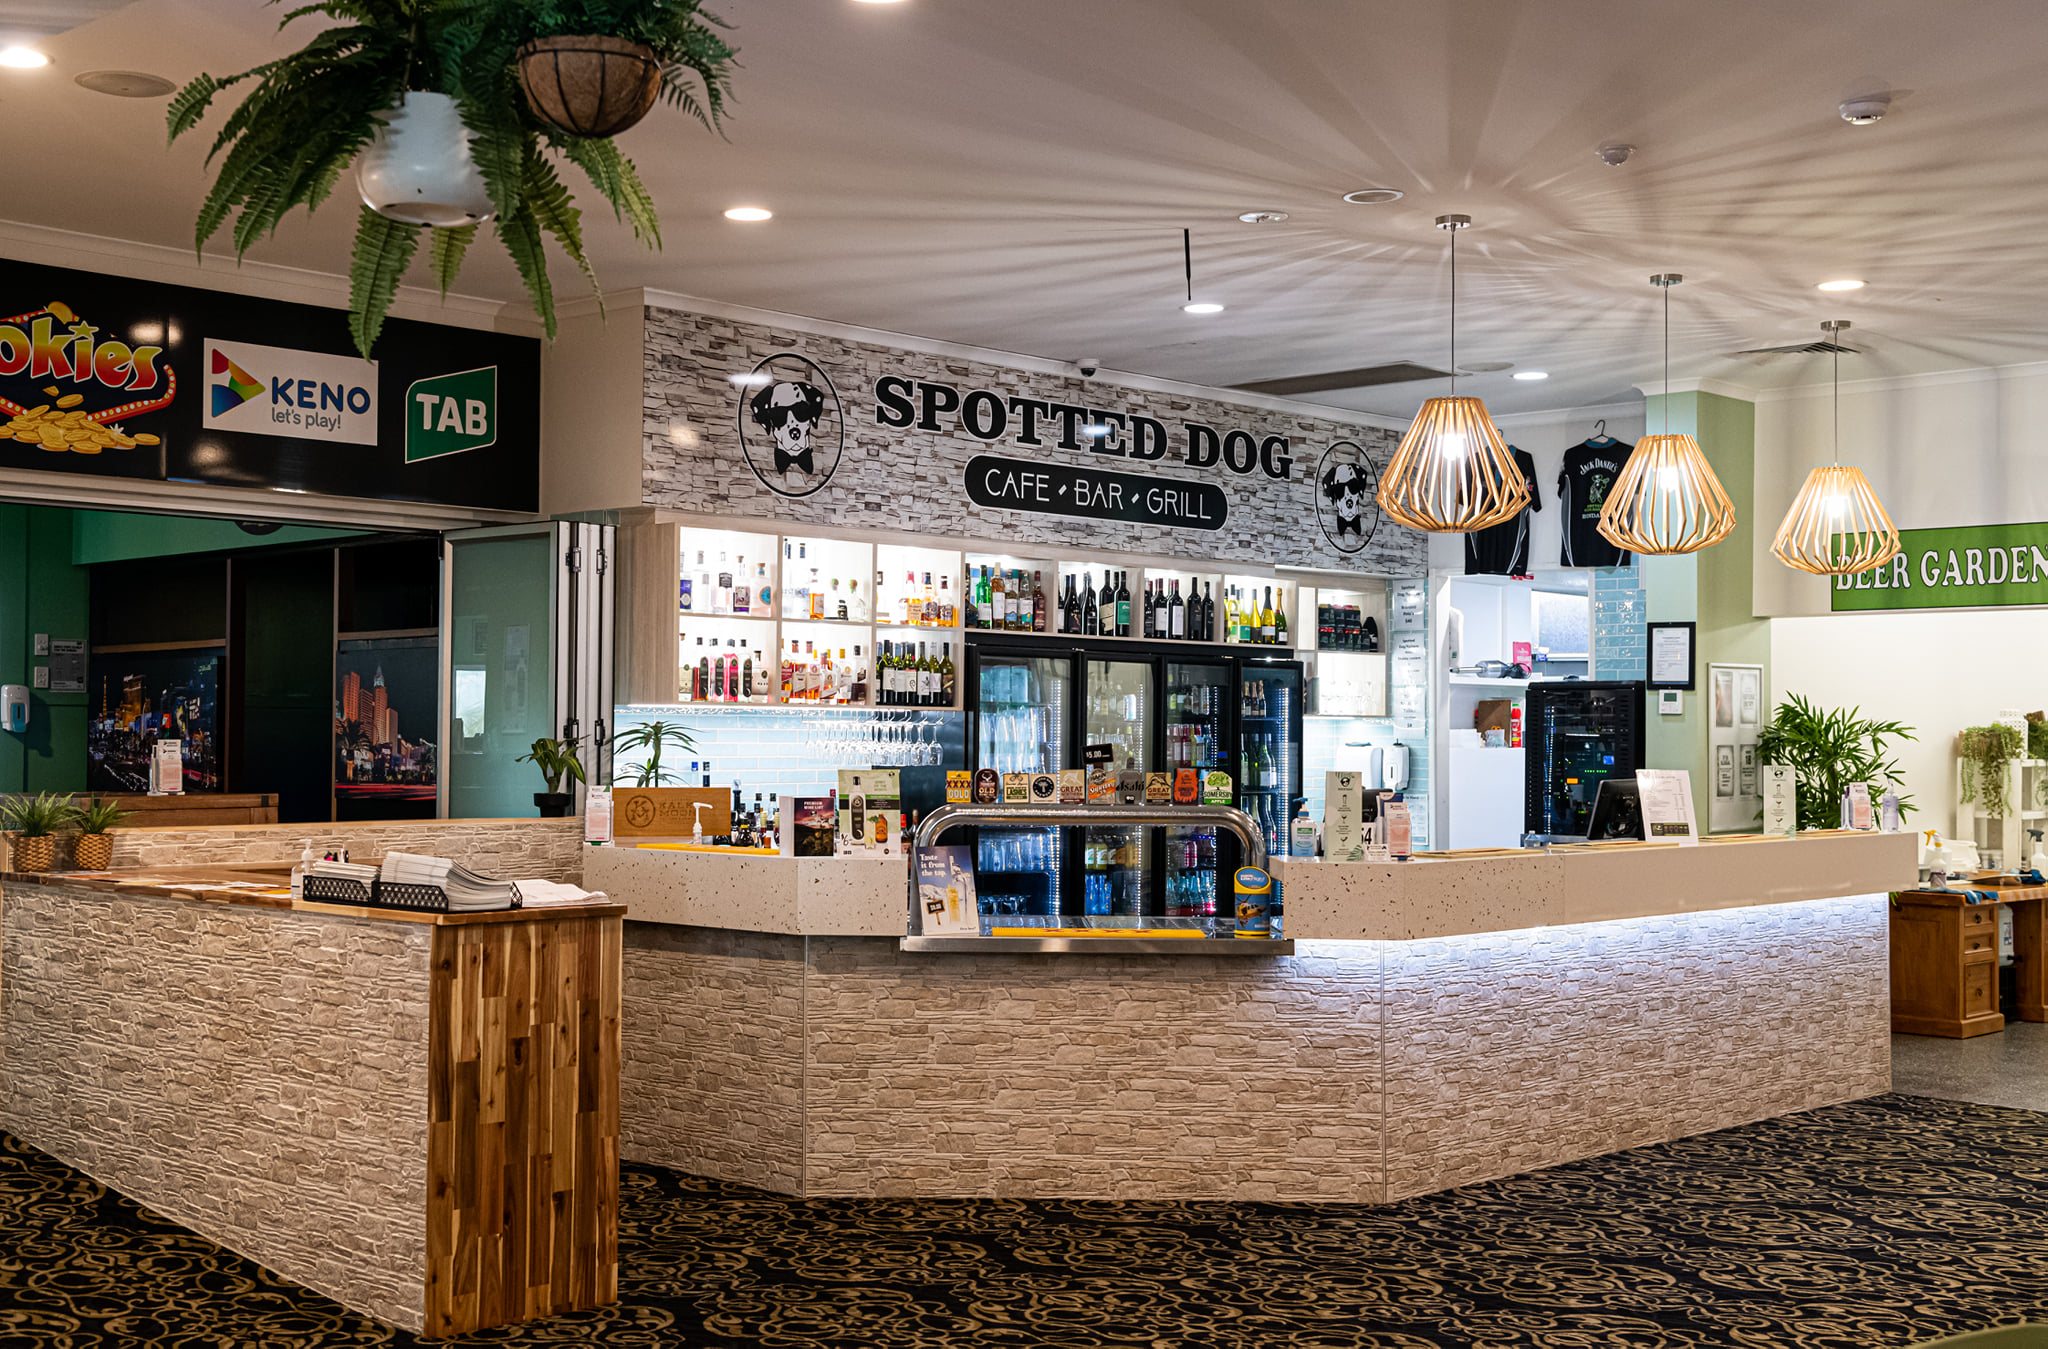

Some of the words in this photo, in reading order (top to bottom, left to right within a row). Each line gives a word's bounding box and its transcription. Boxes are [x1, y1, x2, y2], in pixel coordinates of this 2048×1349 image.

[271, 376, 371, 414] KENO
[271, 407, 301, 425] let's
[305, 413, 341, 432] play!
[416, 393, 488, 436] TAB
[875, 375, 1168, 461] SPOTTED
[1183, 422, 1294, 480] DOG
[985, 469, 1050, 502] CAFE
[1074, 480, 1124, 510] BAR
[1146, 488, 1212, 519] GRILL
[1920, 545, 2048, 588] GARDEN
[946, 780, 971, 788] XXXX
[1116, 781, 1144, 791] Asahi
[948, 789, 969, 798] GOLD
[919, 853, 939, 861] Taste
[928, 861, 946, 869] from
[934, 869, 948, 878] tap.
